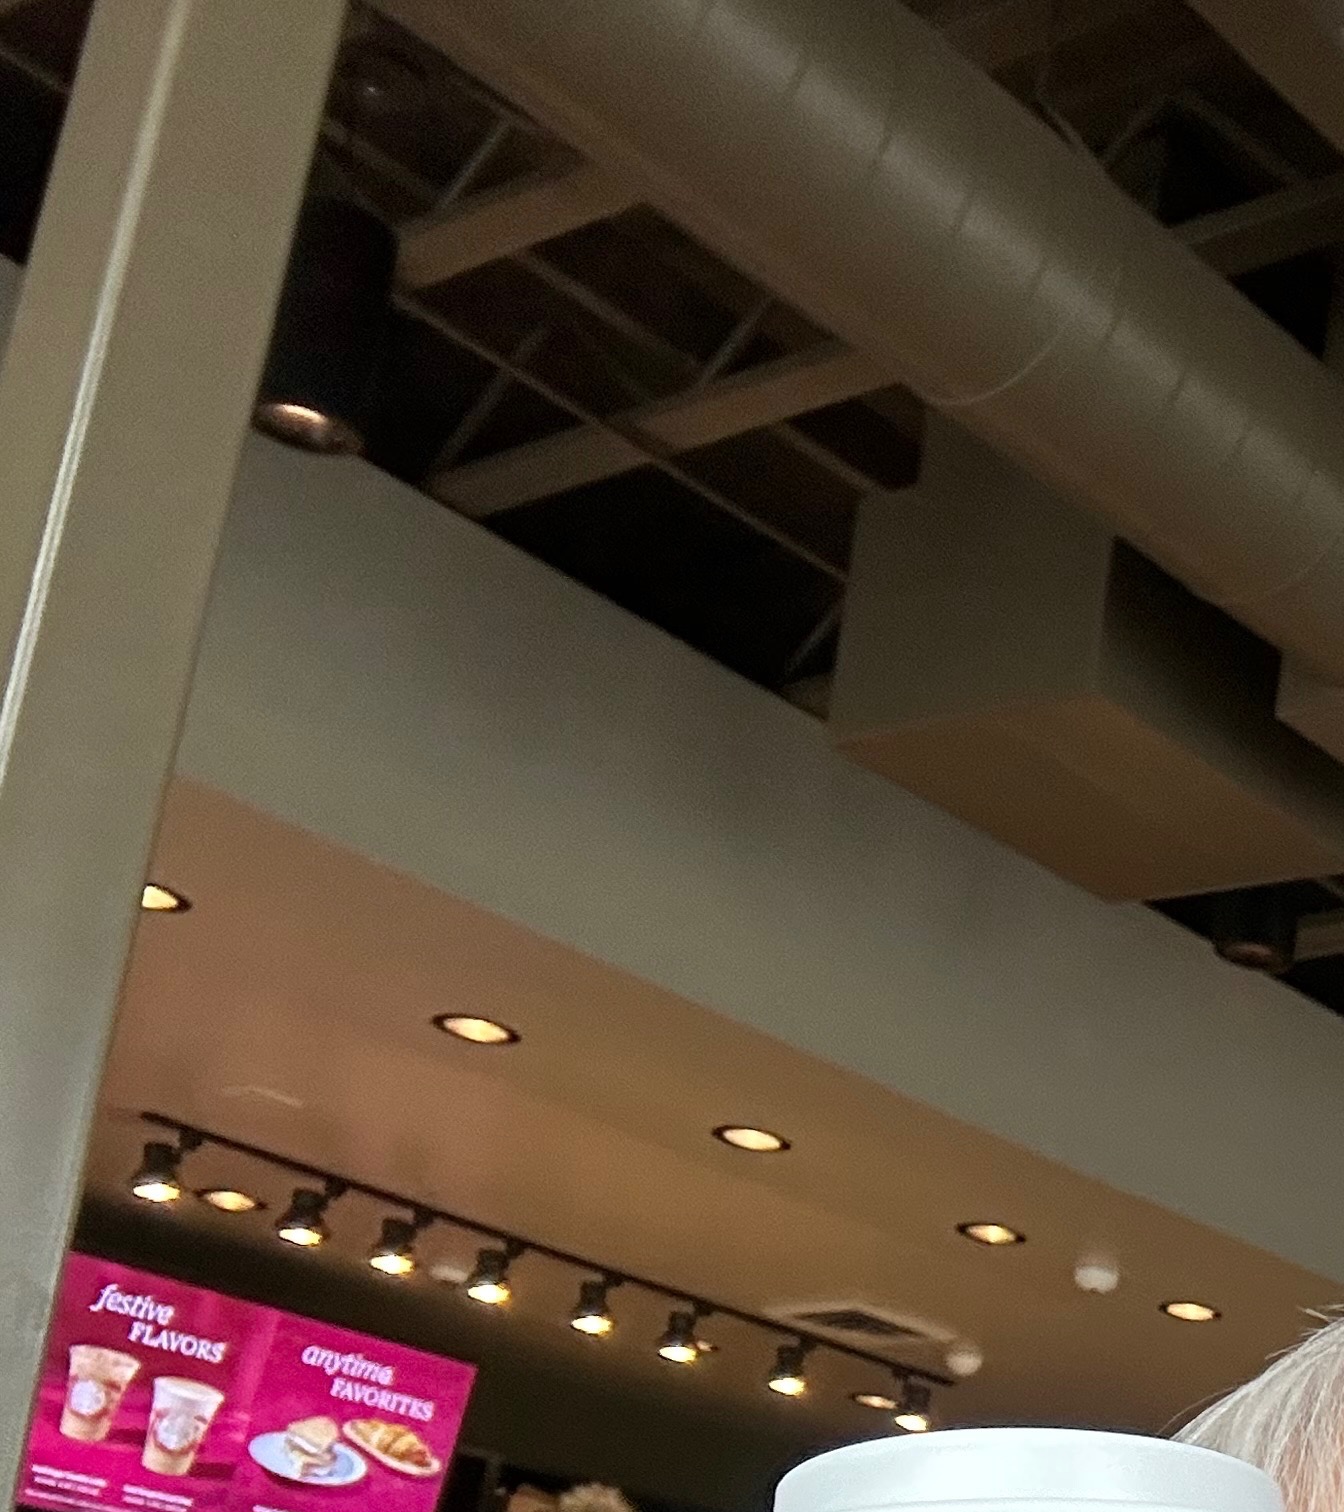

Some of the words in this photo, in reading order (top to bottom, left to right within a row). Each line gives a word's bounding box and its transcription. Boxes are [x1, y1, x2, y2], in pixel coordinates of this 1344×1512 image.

[89, 1283, 175, 1326] festive
[127, 1320, 227, 1364] FLAVORS
[301, 1344, 395, 1386] anytime
[329, 1376, 436, 1422] FAVORITES
